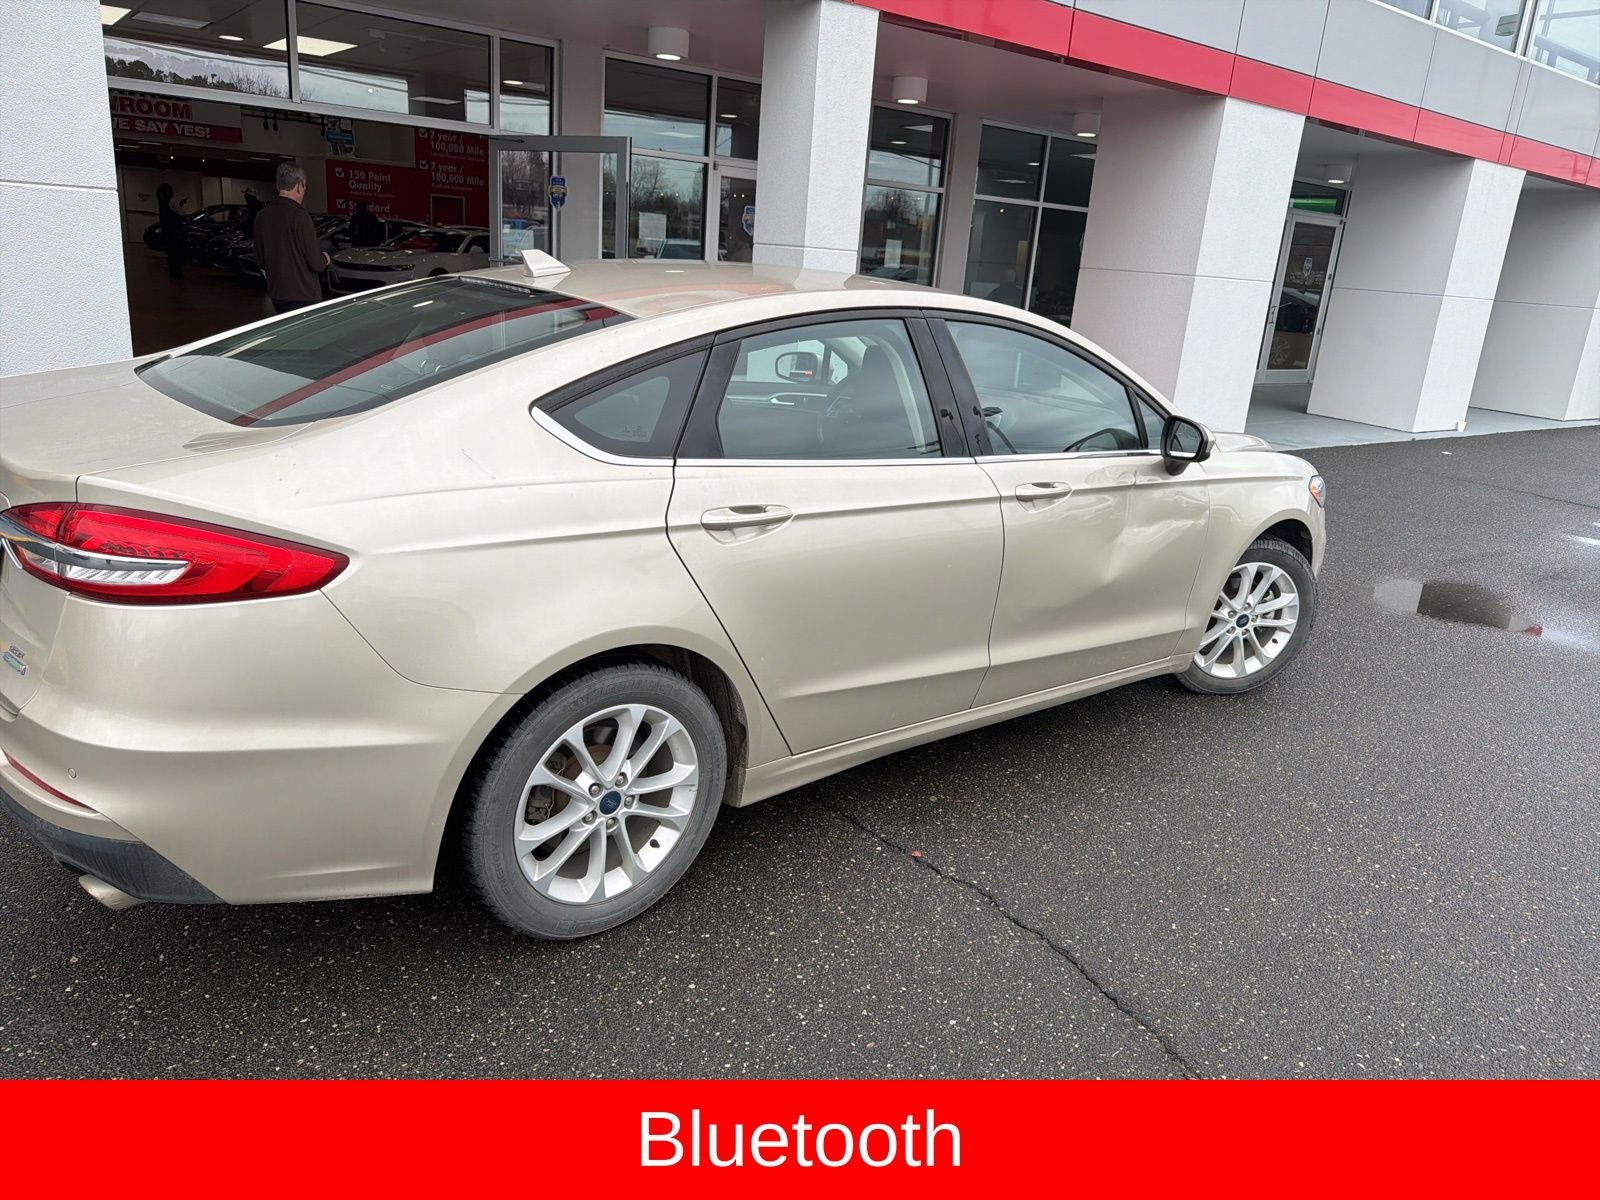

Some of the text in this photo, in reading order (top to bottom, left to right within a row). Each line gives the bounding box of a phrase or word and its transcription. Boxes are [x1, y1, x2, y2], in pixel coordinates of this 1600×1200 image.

[112, 117, 211, 139] E SAY YES!
[436, 132, 458, 142] year
[431, 140, 465, 154] 100,000
[466, 145, 485, 157] Mile
[437, 163, 458, 173] year
[349, 169, 392, 184] 150 Point
[431, 171, 465, 184] 100,000
[466, 175, 485, 187] Mile
[349, 179, 382, 193] Quality
